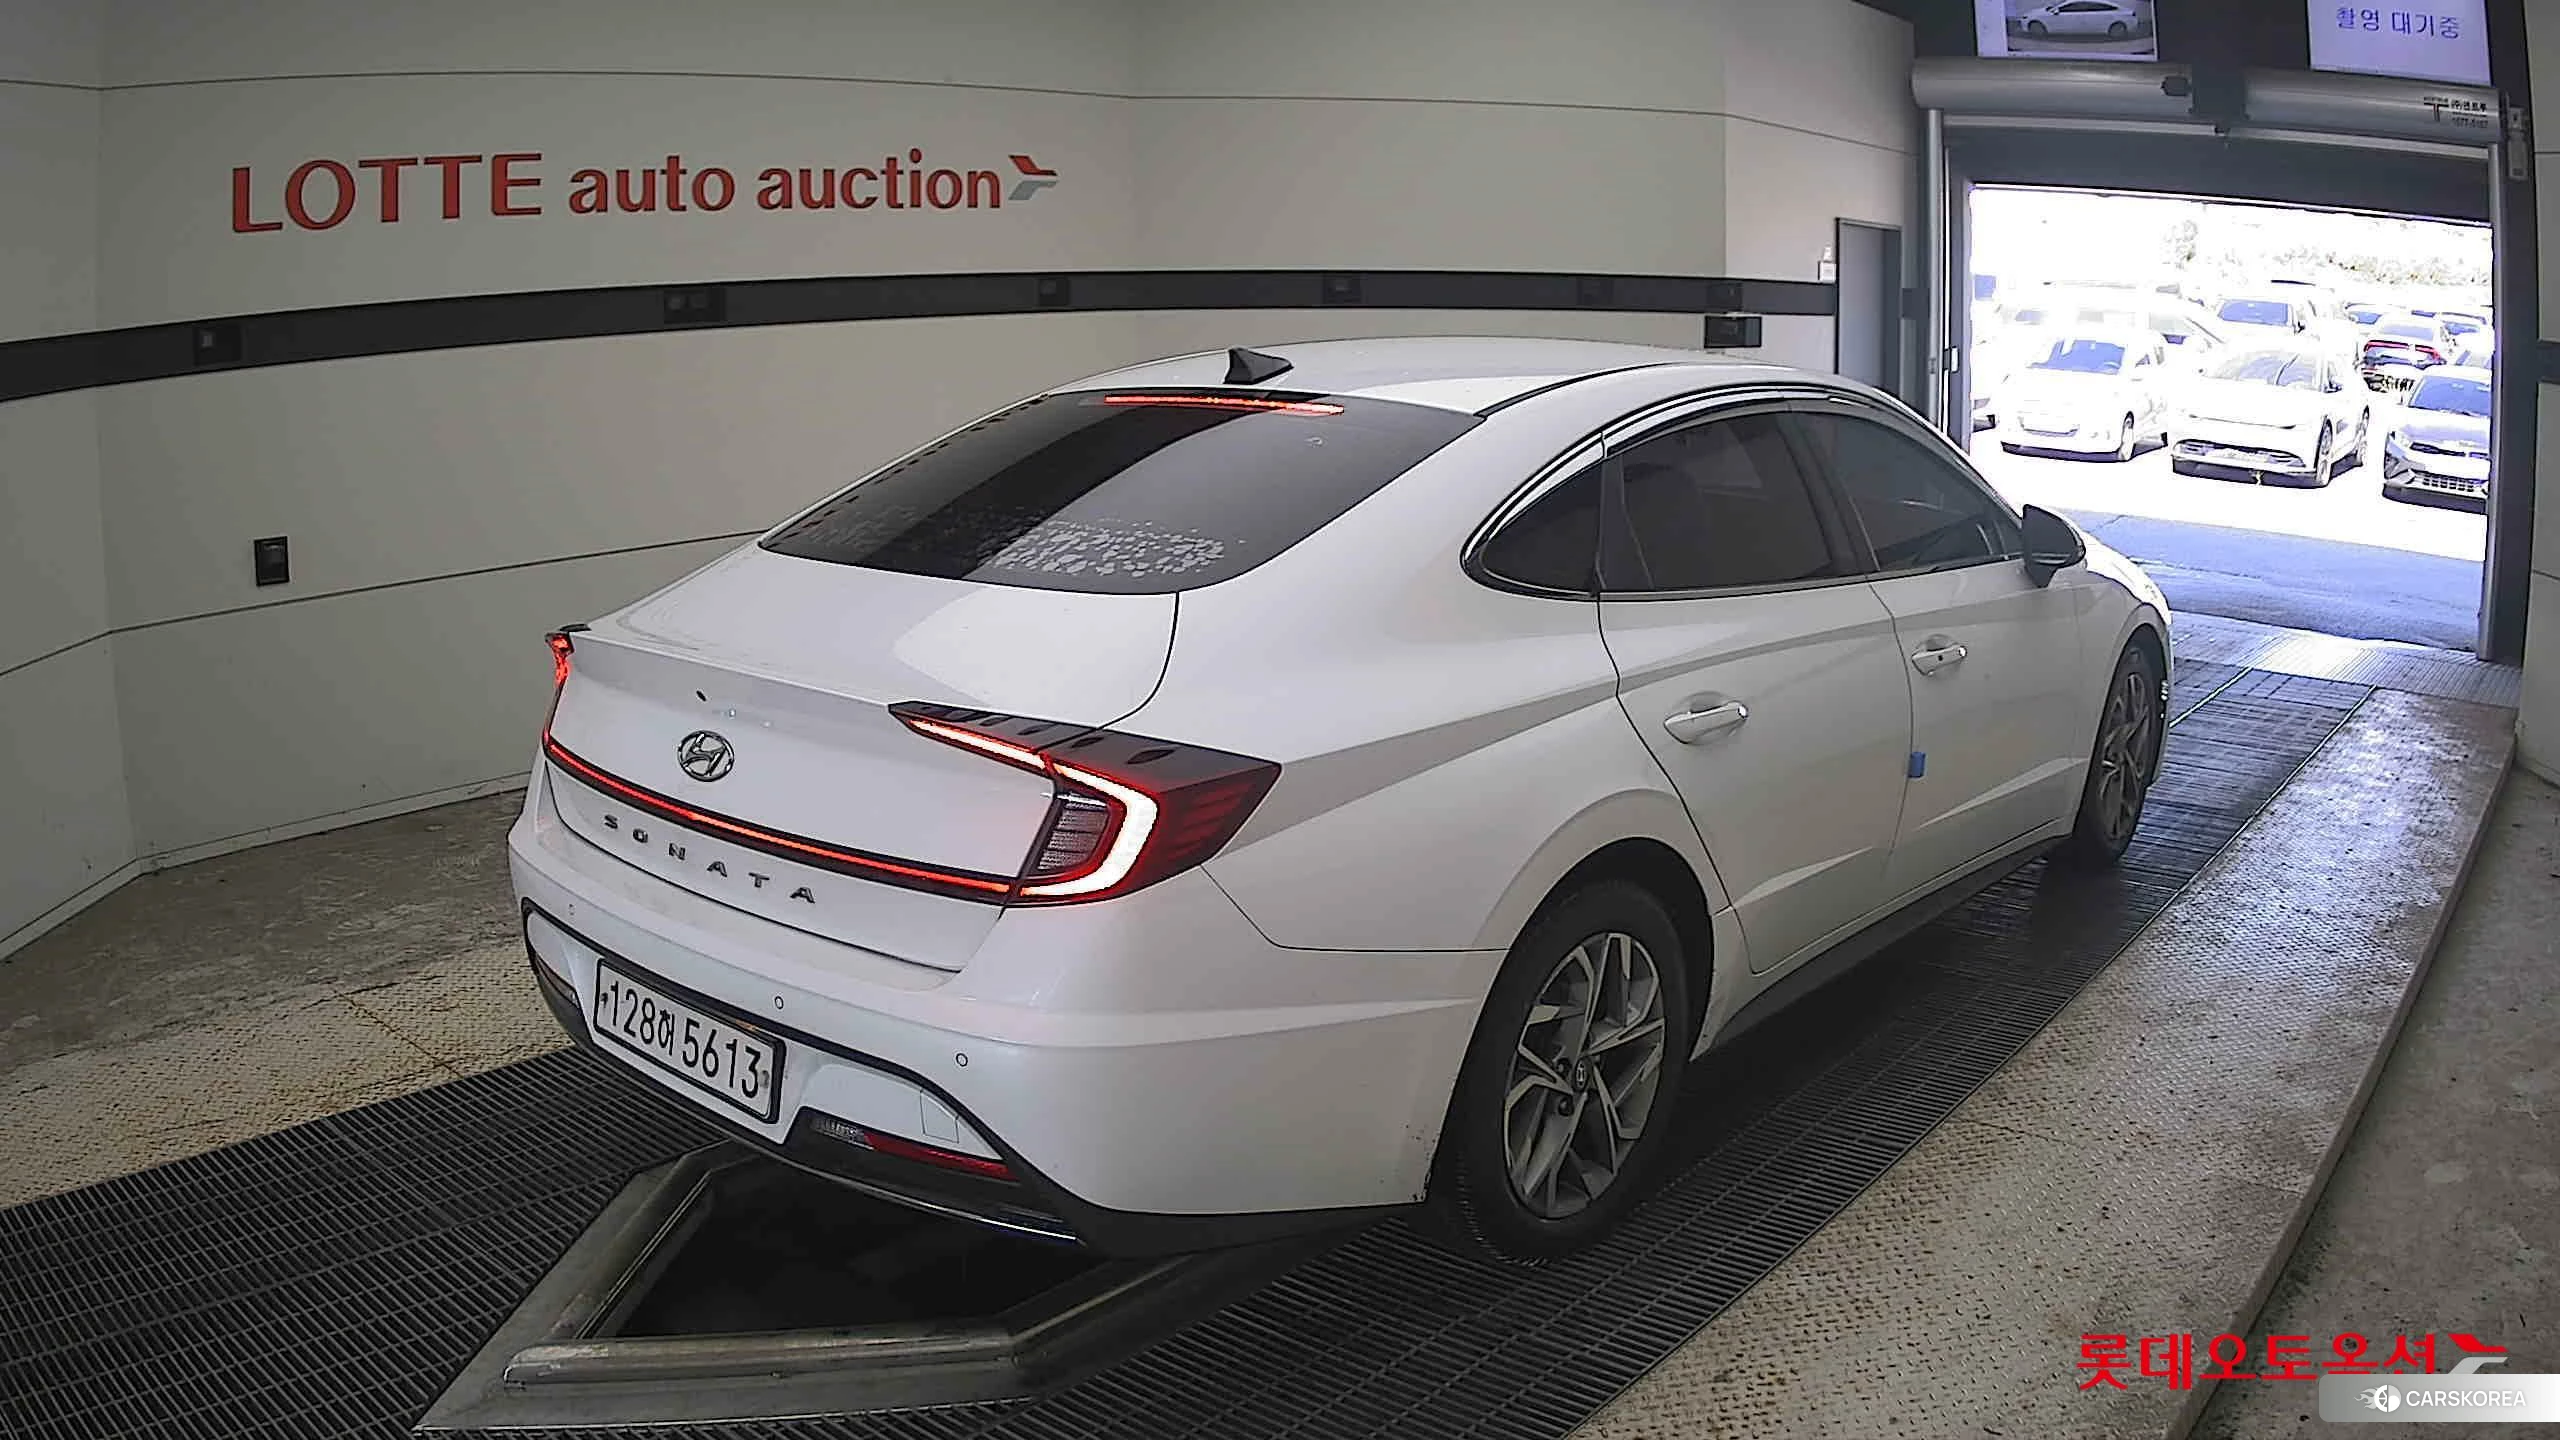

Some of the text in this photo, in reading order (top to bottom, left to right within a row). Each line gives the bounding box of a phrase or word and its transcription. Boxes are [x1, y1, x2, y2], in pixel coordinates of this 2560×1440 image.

[2336, 7, 2460, 39] 촬영 대기중
[232, 148, 1001, 233] LOTTE auto auction
[604, 814, 816, 904] SONATA
